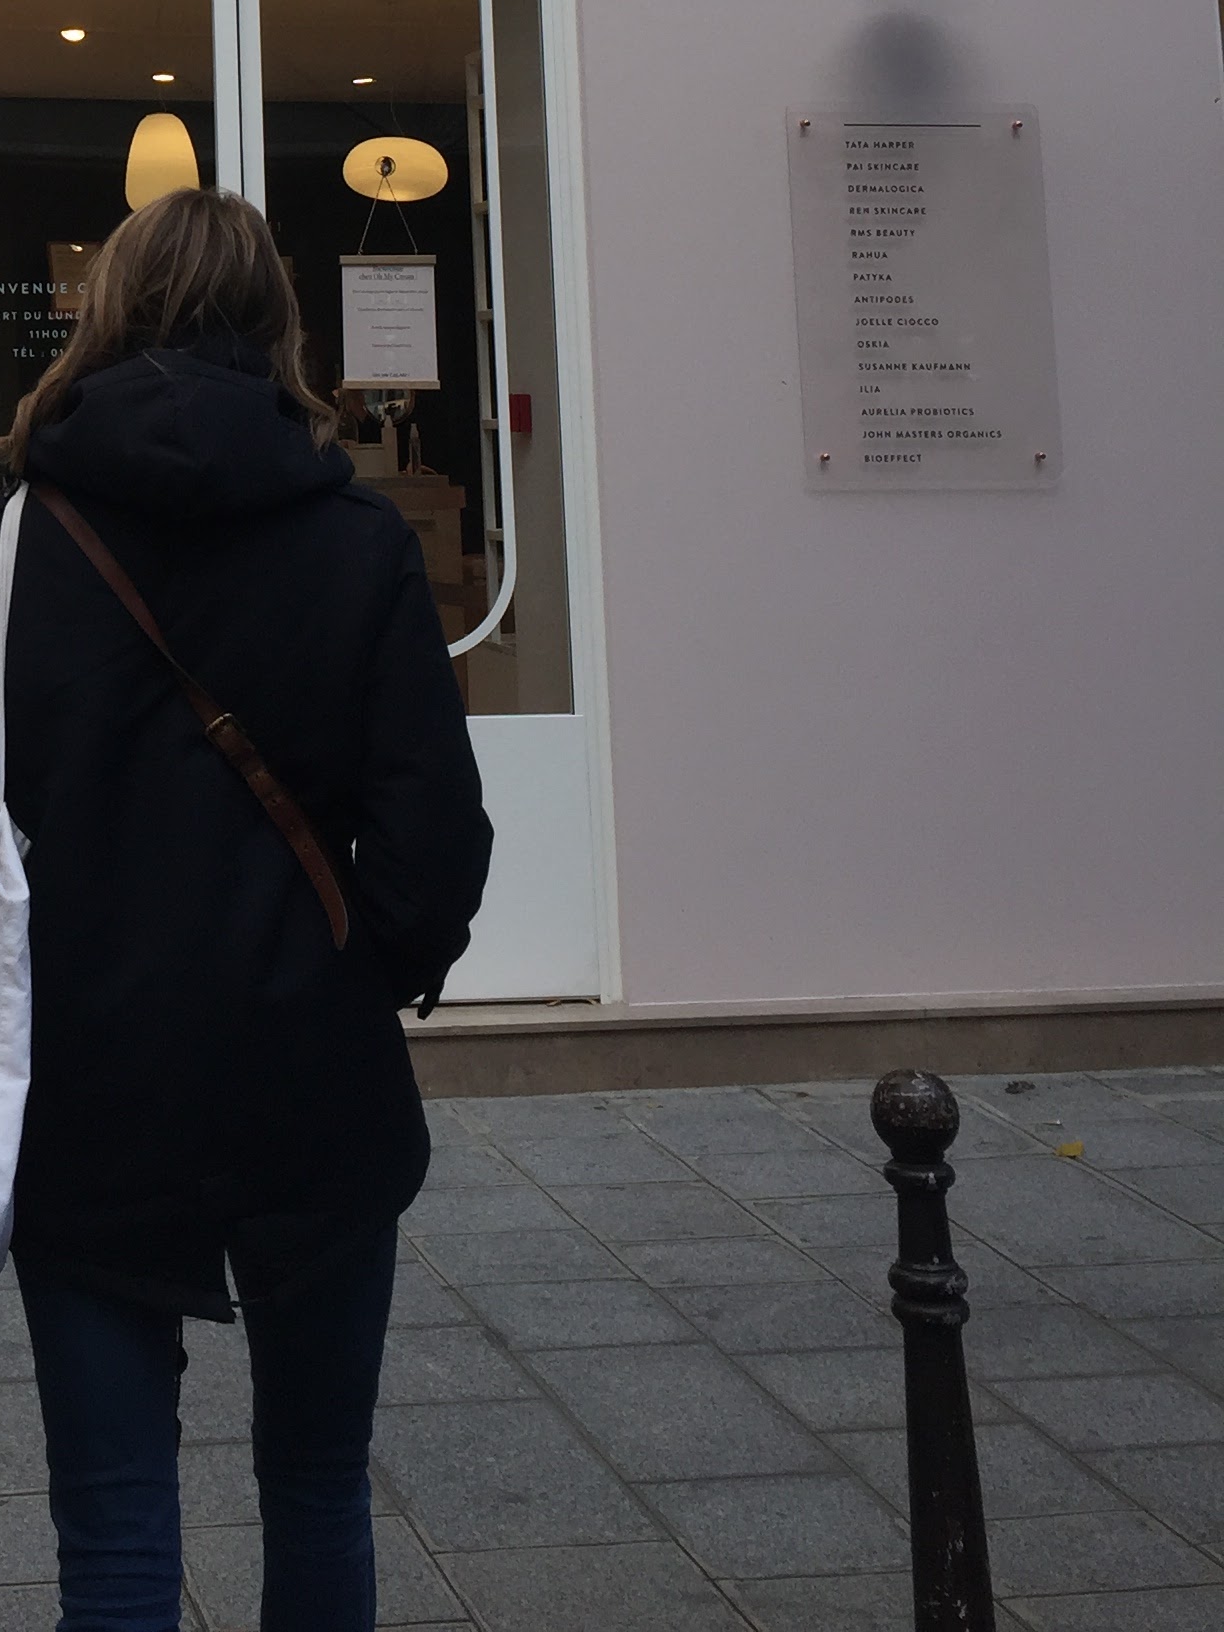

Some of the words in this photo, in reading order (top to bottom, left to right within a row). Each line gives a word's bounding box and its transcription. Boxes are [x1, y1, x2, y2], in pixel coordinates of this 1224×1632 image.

[845, 141, 869, 149] TATA
[873, 141, 915, 149] HARPER
[846, 163, 863, 171] PAI
[867, 163, 919, 171] SKINCARE
[848, 185, 925, 193] DERMALOGICA
[849, 207, 870, 215] REN
[874, 207, 926, 215] SKINCARE
[850, 229, 872, 237] RMS
[876, 229, 915, 237] BEAUTY
[852, 251, 888, 259] RAHUA
[853, 273, 892, 281] PATYKA
[854, 296, 914, 304] ANTIPODES
[24, 310, 42, 321] DU
[855, 318, 893, 326] JOELLE
[897, 318, 939, 326] CIOCCO
[29, 329, 68, 339] 11H00
[857, 340, 890, 348] OSKIA
[858, 363, 907, 371] SUSANNE
[911, 362, 971, 371] KAUFMANN
[859, 385, 881, 393] ILIA
[861, 408, 906, 416] AURELIA
[910, 408, 975, 416] PROBIOTICS
[863, 430, 891, 439] JOHN
[896, 430, 943, 439] MASTERS
[947, 430, 1002, 439] ORGANICS
[864, 454, 922, 463] BIOEFFECT
